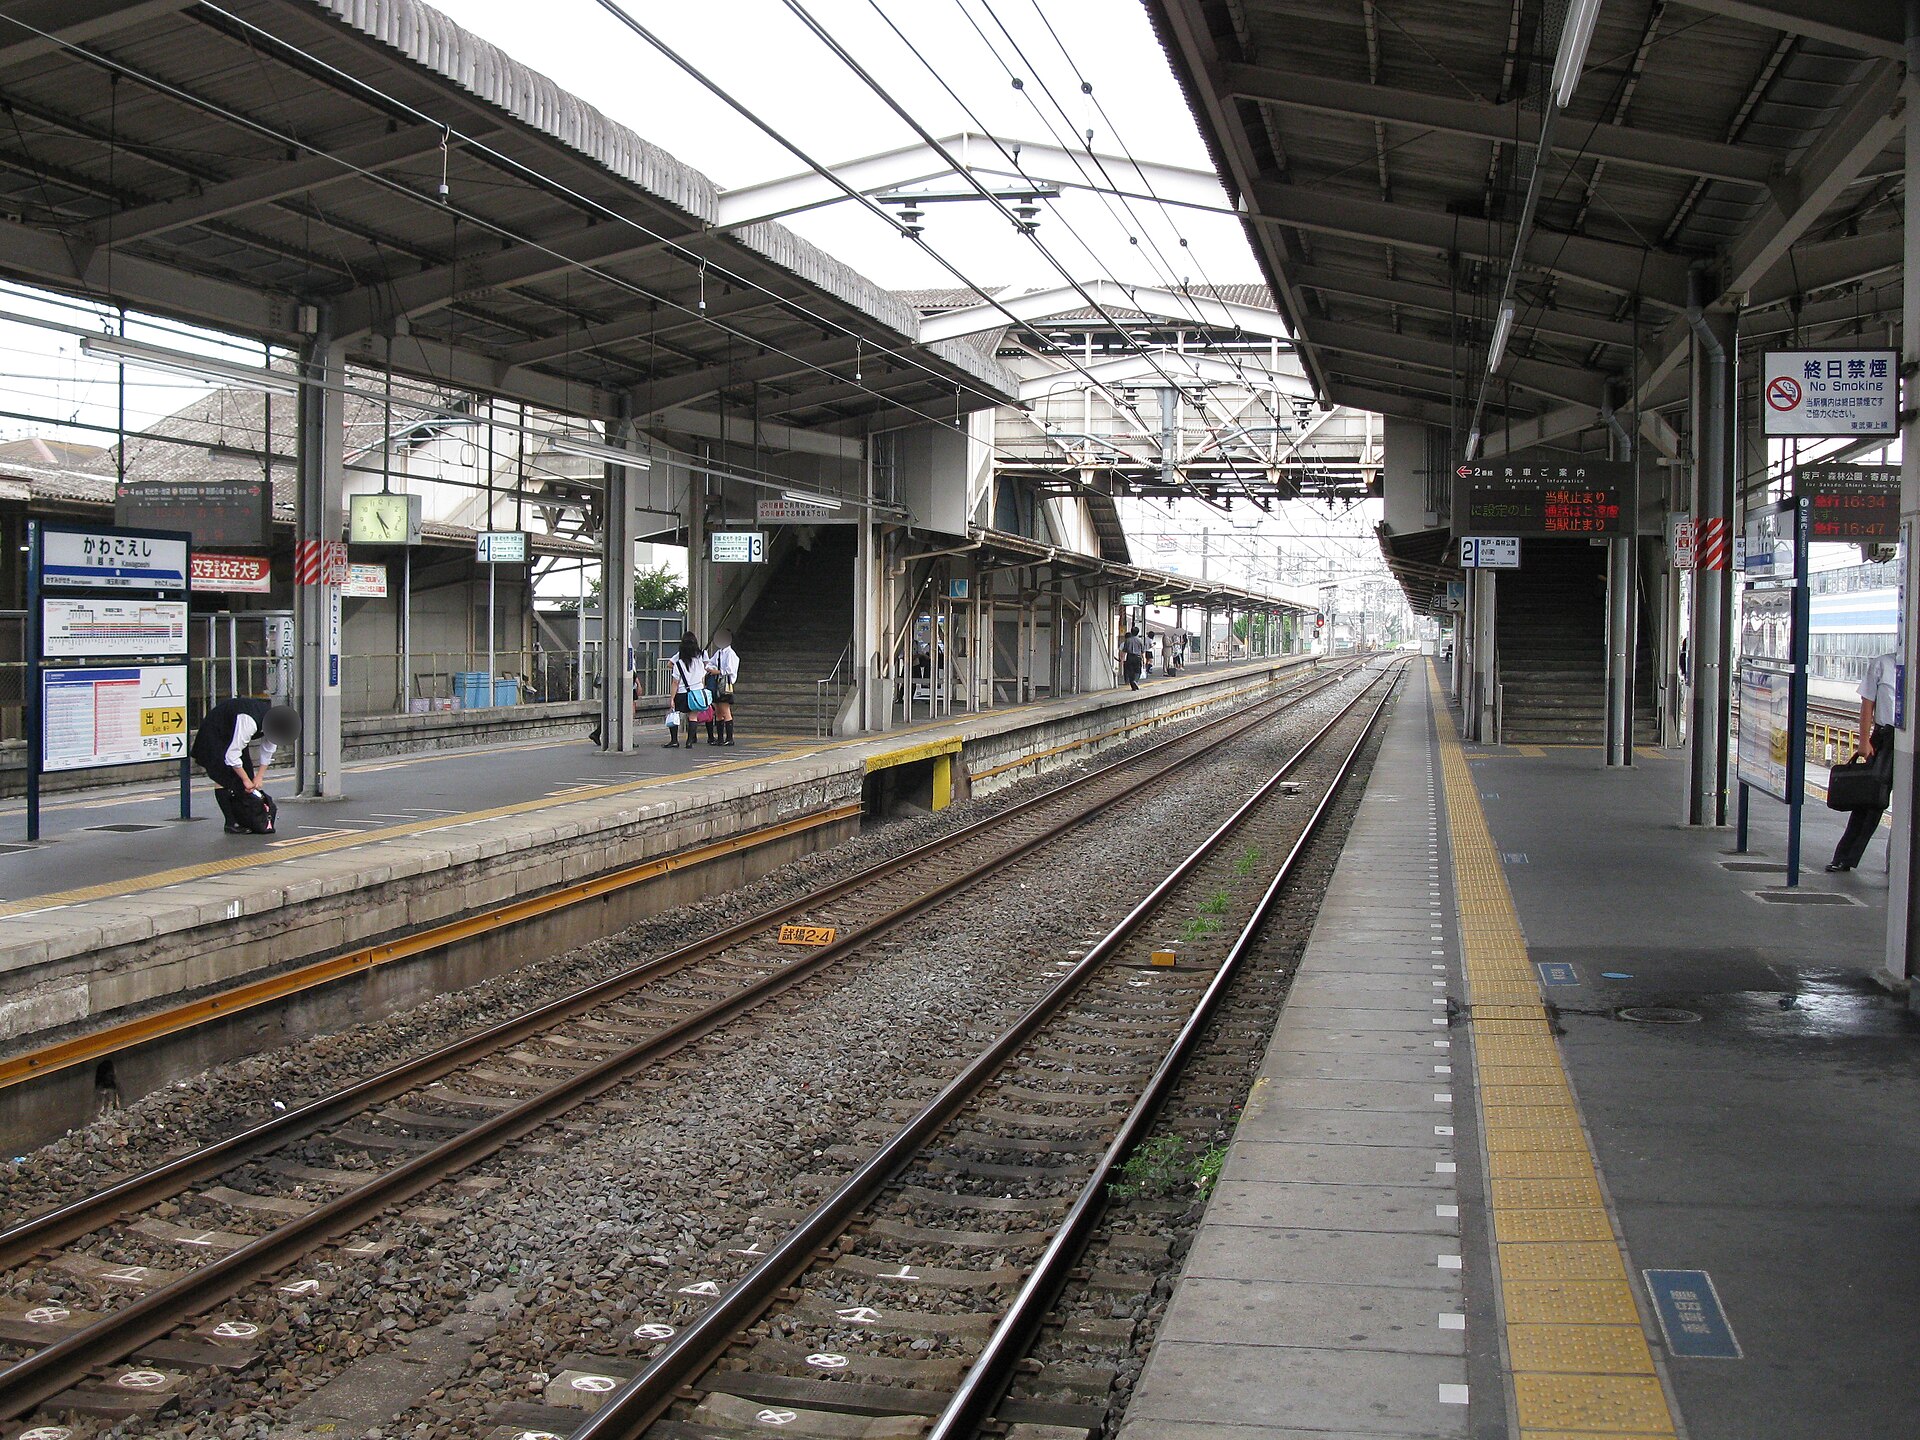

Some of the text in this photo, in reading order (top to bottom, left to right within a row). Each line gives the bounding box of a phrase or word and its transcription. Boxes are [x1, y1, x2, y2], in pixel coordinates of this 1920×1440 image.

[1804, 359, 1888, 379] 終日禁煙
[1810, 381, 1883, 391] No Smoking
[1806, 398, 1885, 407] 当駅構内は終日禁煙です
[1806, 410, 1856, 418] ご協力ください。
[1474, 467, 1586, 477] 2番線 発車ご案内
[1545, 491, 1606, 504] 当駅止まり
[1814, 495, 1886, 508] 急行 16:34
[1471, 504, 1533, 517] に設定の上
[1545, 505, 1619, 518] 通話はご遠慮
[1545, 518, 1606, 531] 当駅止まり
[1814, 522, 1885, 535] 急行 16:47
[84, 537, 152, 557] かわごえし
[479, 540, 486, 555] 4
[753, 539, 762, 556] 3
[1463, 541, 1473, 560] 2
[87, 556, 114, 566] 川越市
[145, 712, 170, 725] 出口
